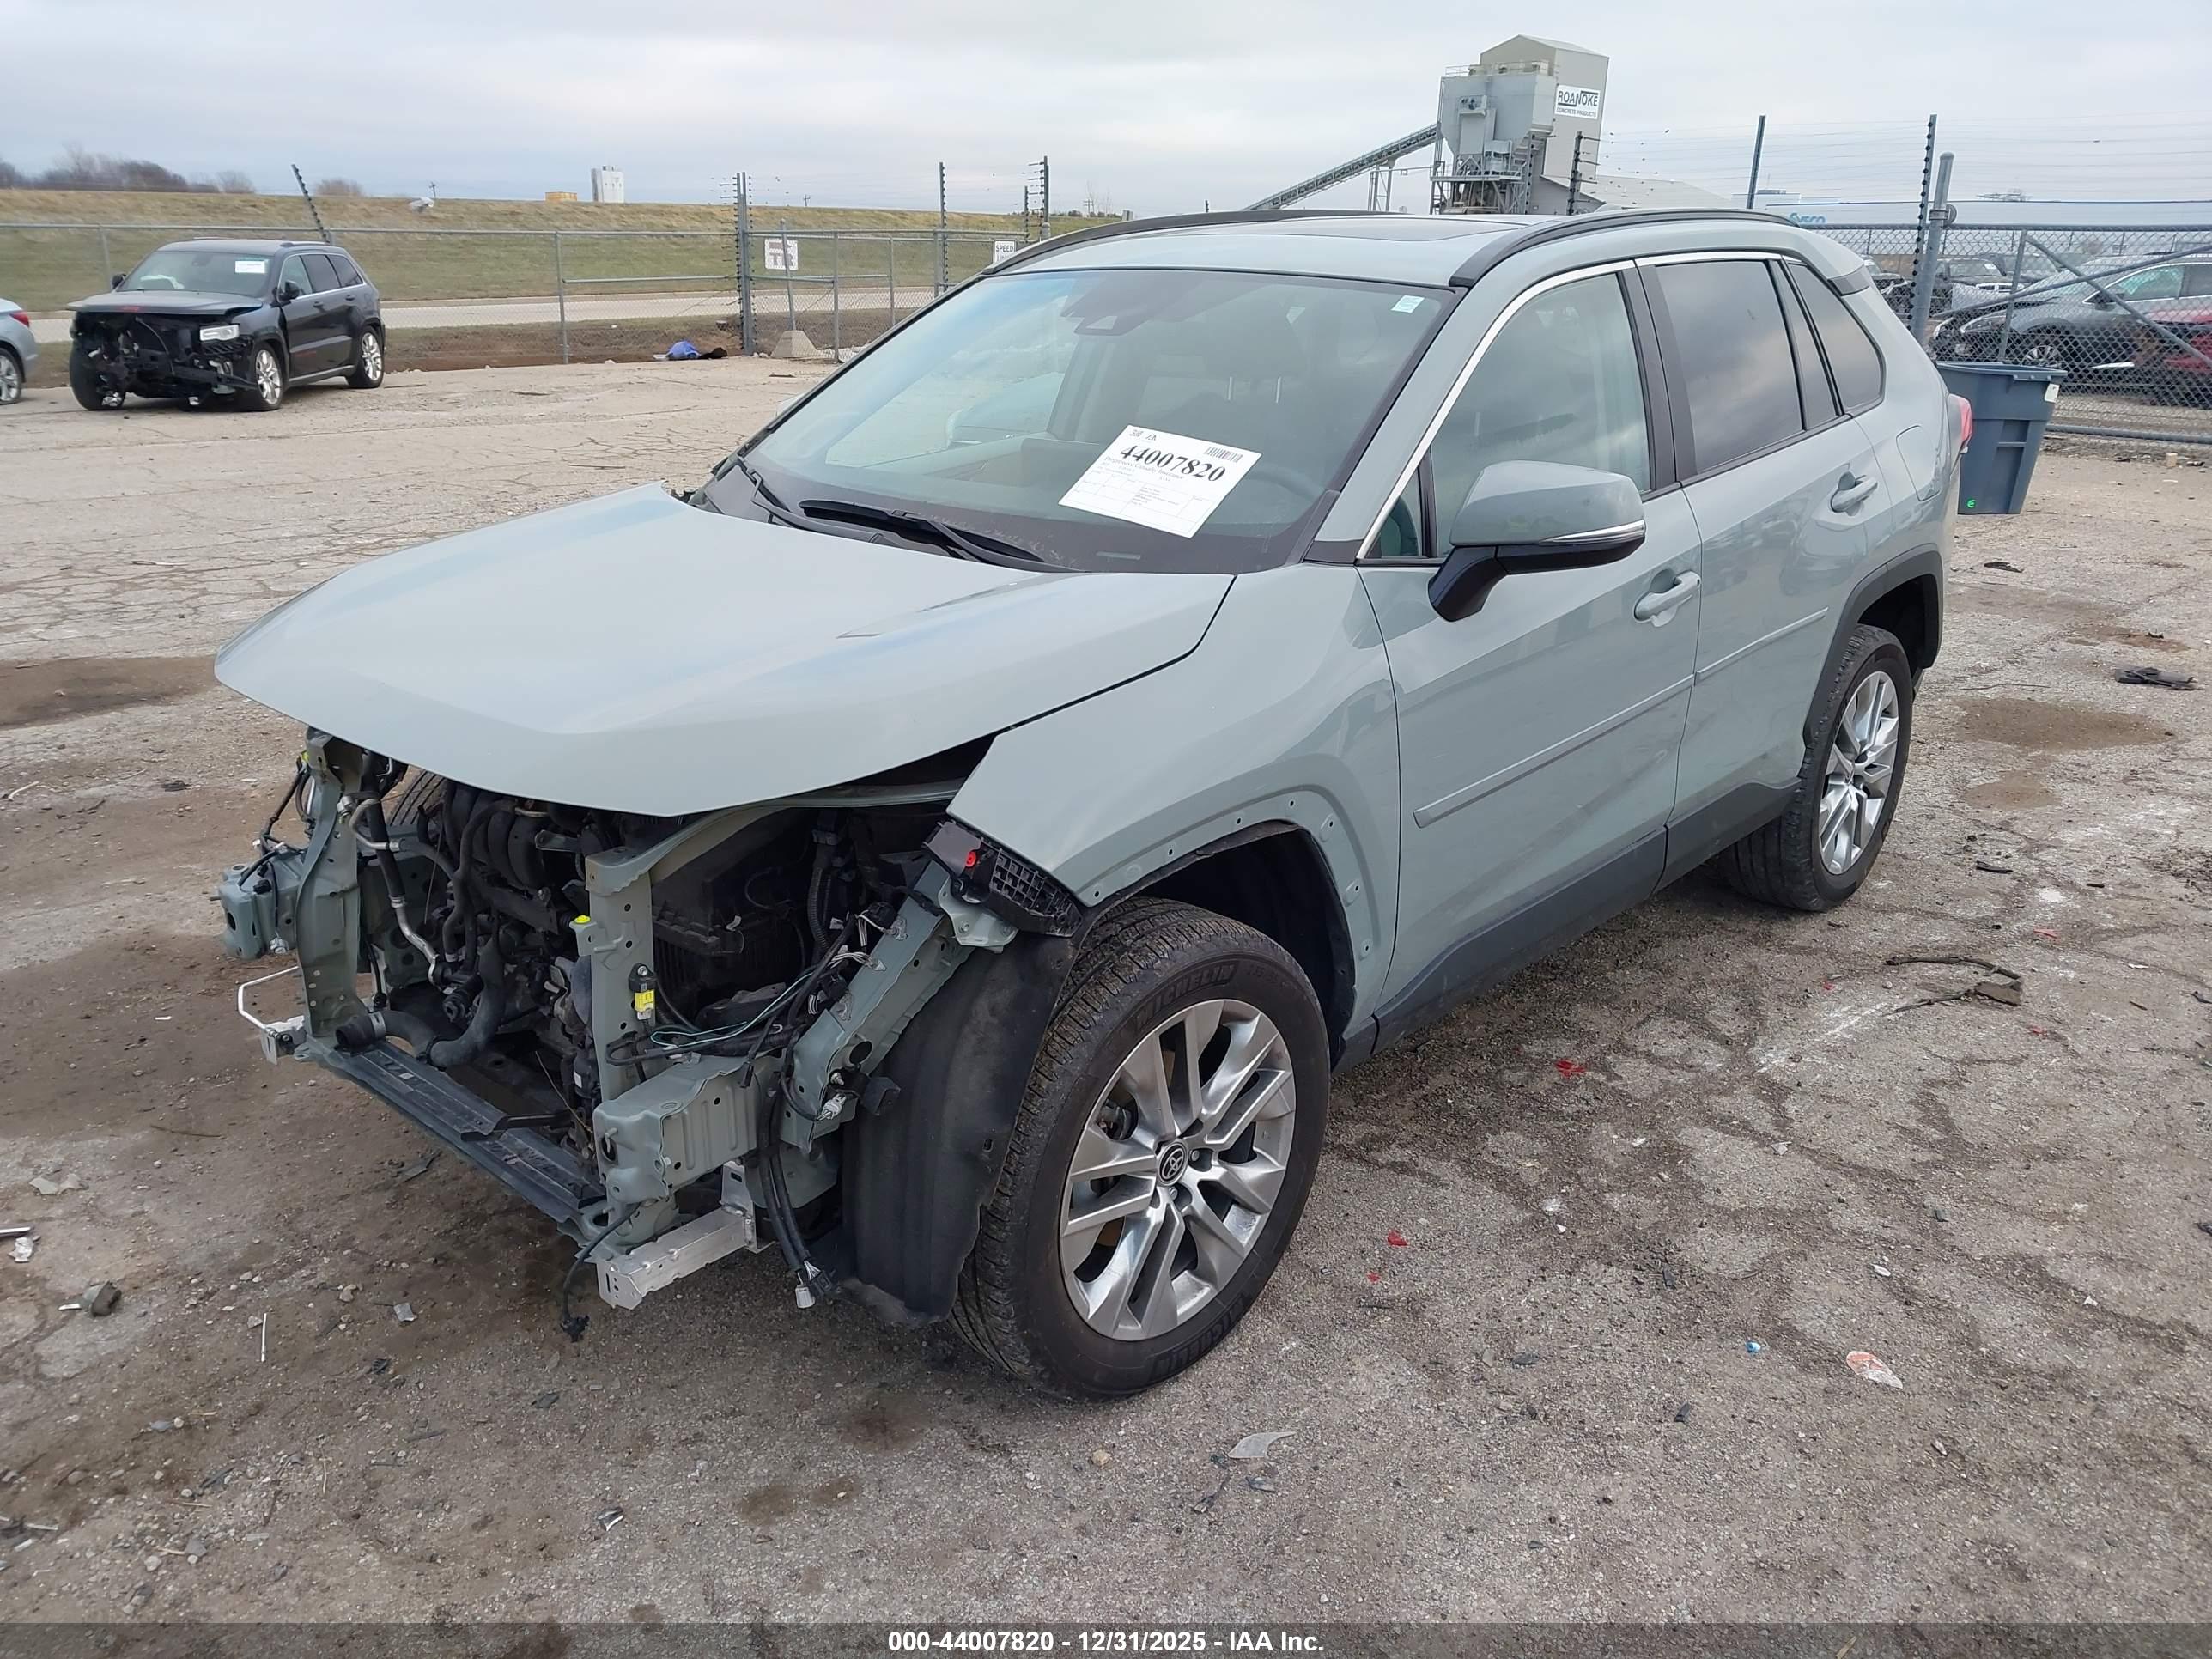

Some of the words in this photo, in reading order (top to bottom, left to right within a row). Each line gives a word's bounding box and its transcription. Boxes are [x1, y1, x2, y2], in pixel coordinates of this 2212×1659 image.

[1558, 91, 1598, 106] ROANOKE
[1120, 445, 1226, 482] 44007820
[1136, 963, 1237, 1031] MICHELIN
